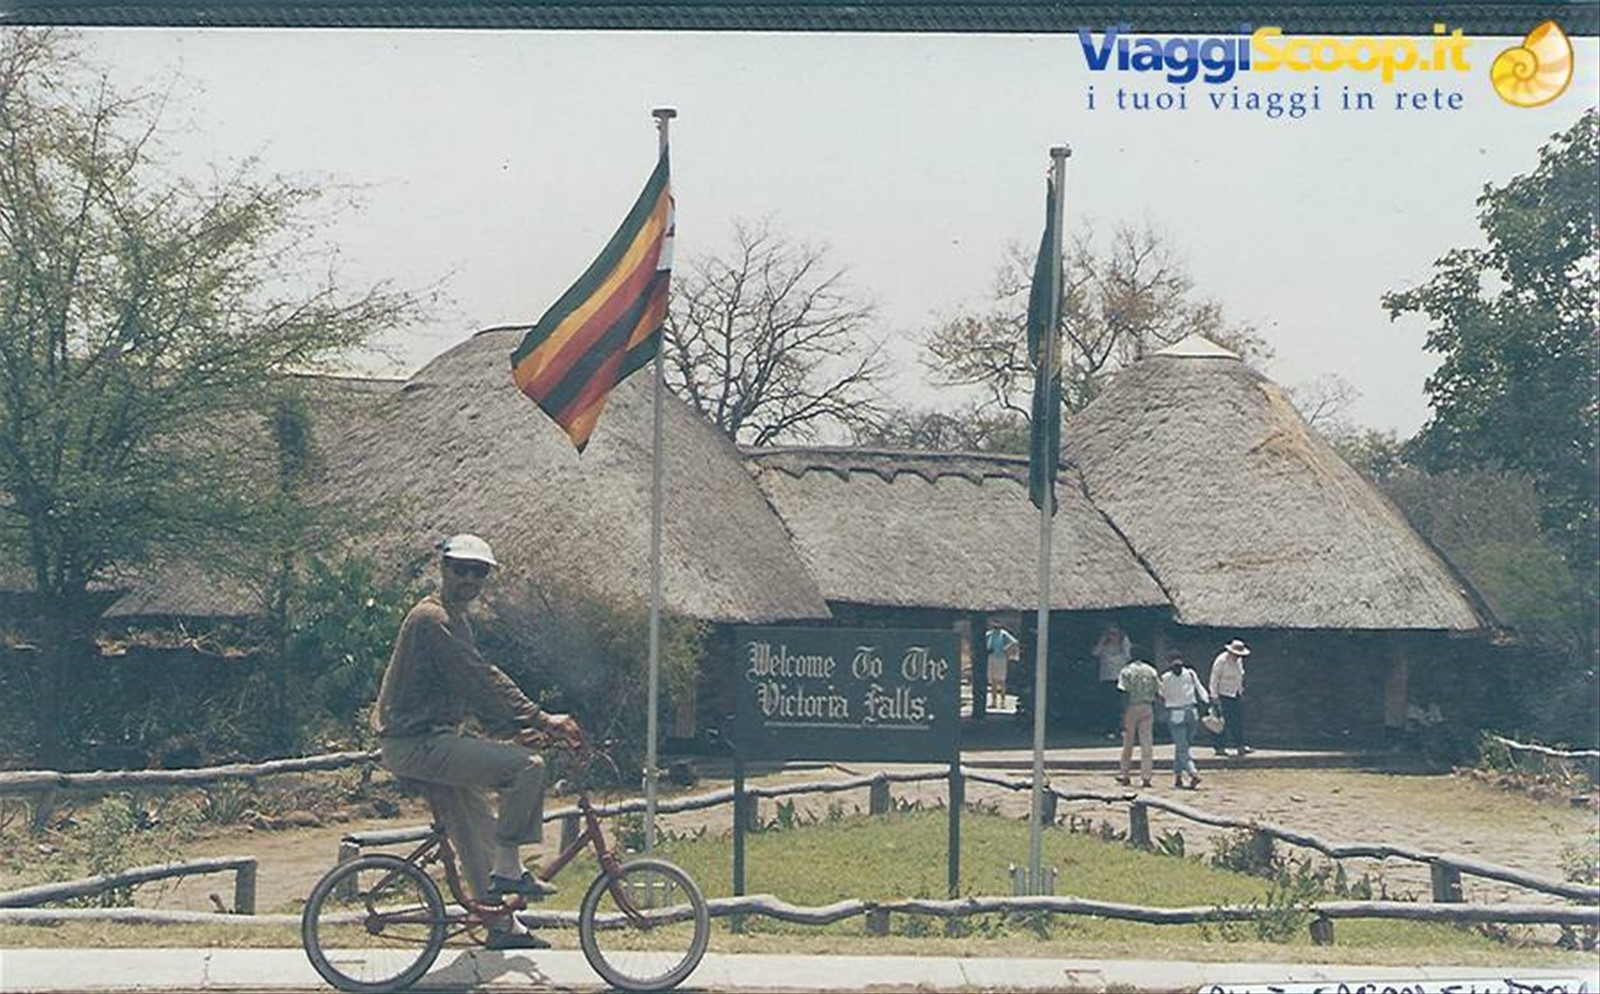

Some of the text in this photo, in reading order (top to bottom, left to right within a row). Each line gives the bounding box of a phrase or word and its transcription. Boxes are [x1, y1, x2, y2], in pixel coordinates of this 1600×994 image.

[745, 640, 948, 684] Welcome To The
[757, 680, 935, 726] Victoria Falls.
